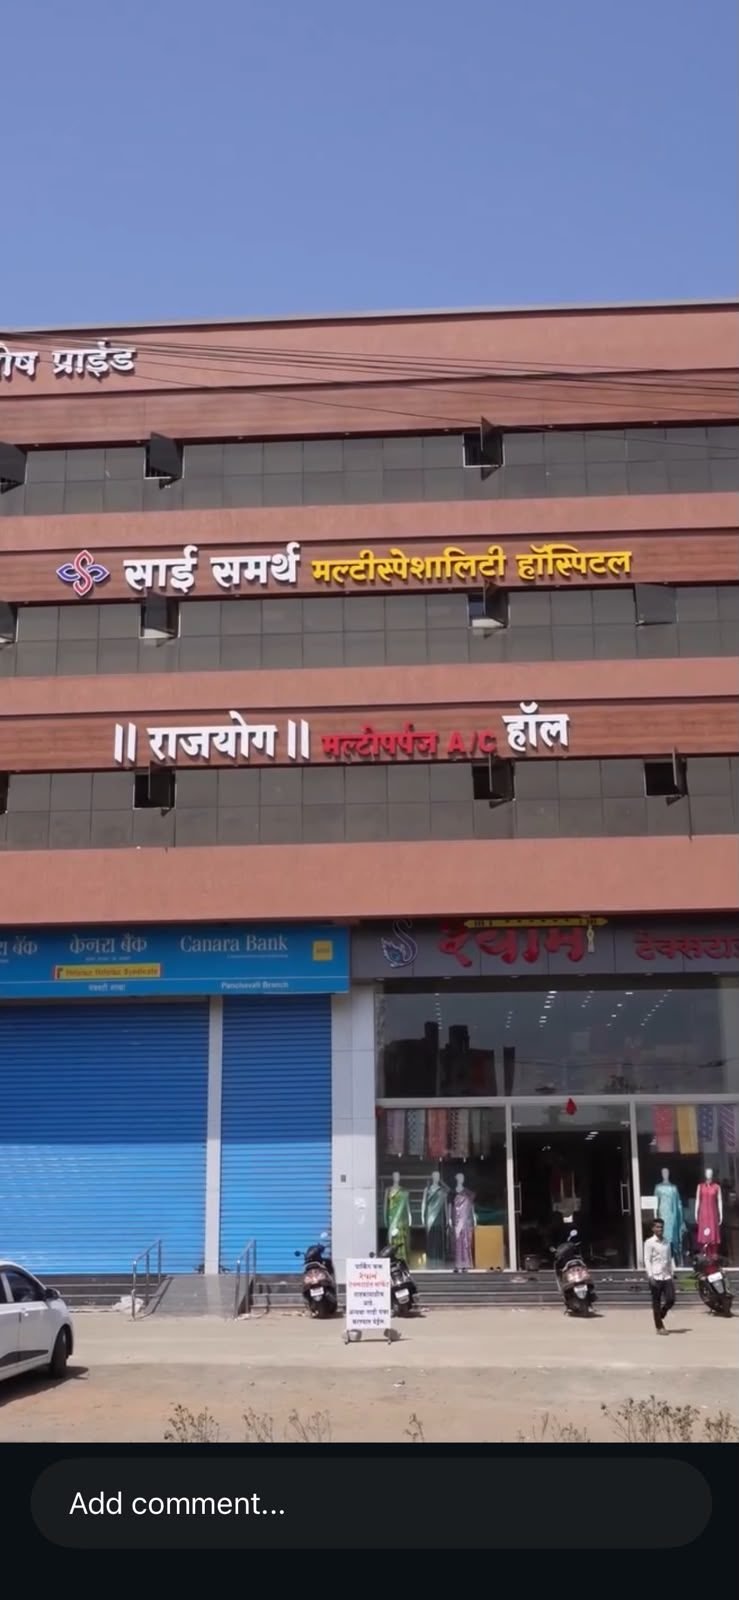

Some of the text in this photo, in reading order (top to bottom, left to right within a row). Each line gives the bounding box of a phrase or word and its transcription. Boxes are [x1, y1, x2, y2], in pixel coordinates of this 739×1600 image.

[123, 542, 632, 593] साई समर्थ मल्टीस्पेशालिटी हॉस्पिटल
[146, 710, 278, 761] राजयोग
[502, 702, 570, 751] हॉल
[180, 934, 289, 952] Canara Bank
